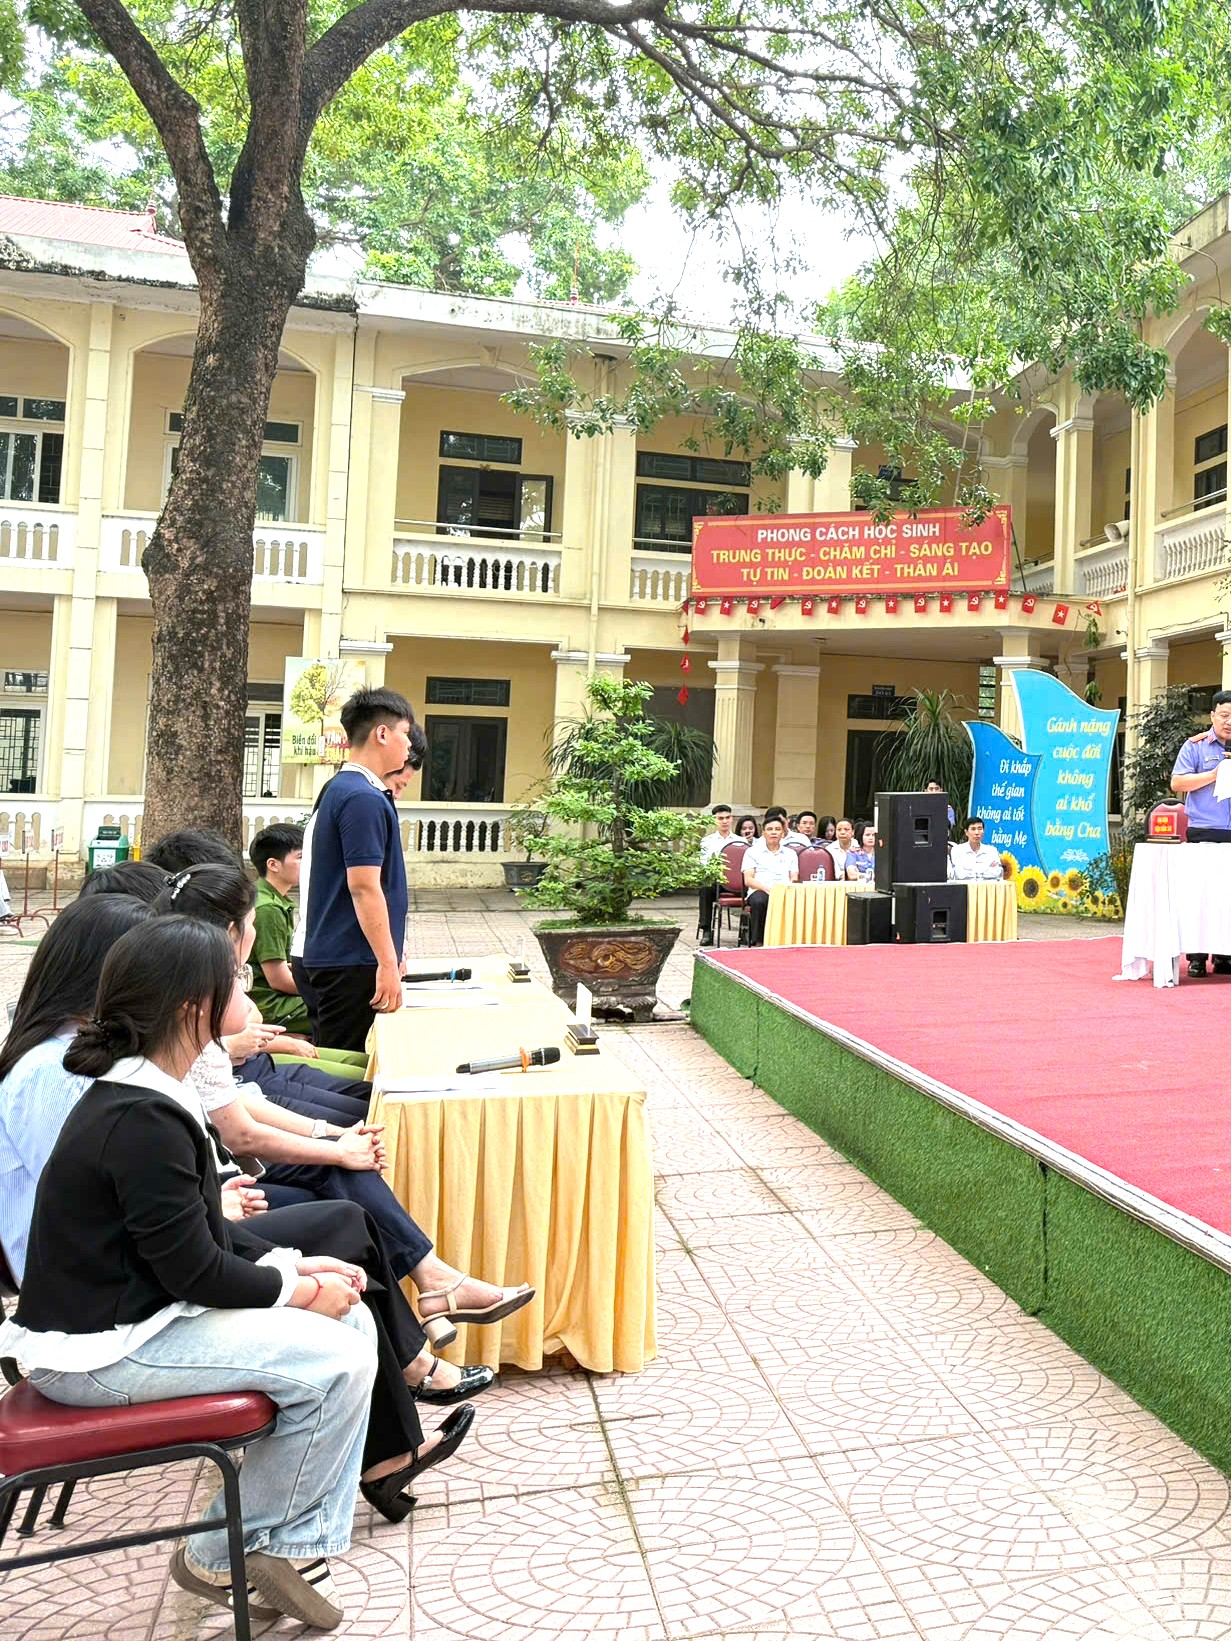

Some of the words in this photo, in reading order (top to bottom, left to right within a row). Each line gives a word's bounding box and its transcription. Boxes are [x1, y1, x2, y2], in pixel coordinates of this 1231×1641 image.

[758, 527, 811, 543] PHONG
[816, 524, 859, 540] CÁCH
[864, 525, 897, 542] HỌC
[902, 523, 940, 538] SINH
[711, 549, 761, 563] TRUNG
[766, 547, 806, 565] THỰC
[820, 543, 865, 560] CHĂM
[870, 540, 896, 558] CHỈ
[910, 541, 954, 557] SÁNG
[959, 541, 992, 559] TẠO
[741, 567, 762, 585] TỰ
[765, 567, 789, 580] TIN
[802, 563, 847, 580] ĐOÀN
[852, 559, 881, 578] KẾT
[894, 562, 937, 577] THÂN
[942, 560, 958, 576] ÁI
[1053, 744, 1079, 761] cuộc
[1000, 759, 1010, 774] Đi
[1011, 757, 1032, 777] khắp
[1057, 770, 1094, 788] không
[992, 781, 1006, 797] thế
[1006, 783, 1025, 800] gian
[1056, 796, 1068, 811] ai
[977, 806, 1001, 823] không
[1002, 809, 1011, 821] ai
[1013, 805, 1024, 821] tốt
[991, 828, 1012, 846] bằng
[1014, 831, 1027, 848] Mẹ
[1045, 818, 1075, 840] bằng
[1078, 822, 1101, 838] Cha
